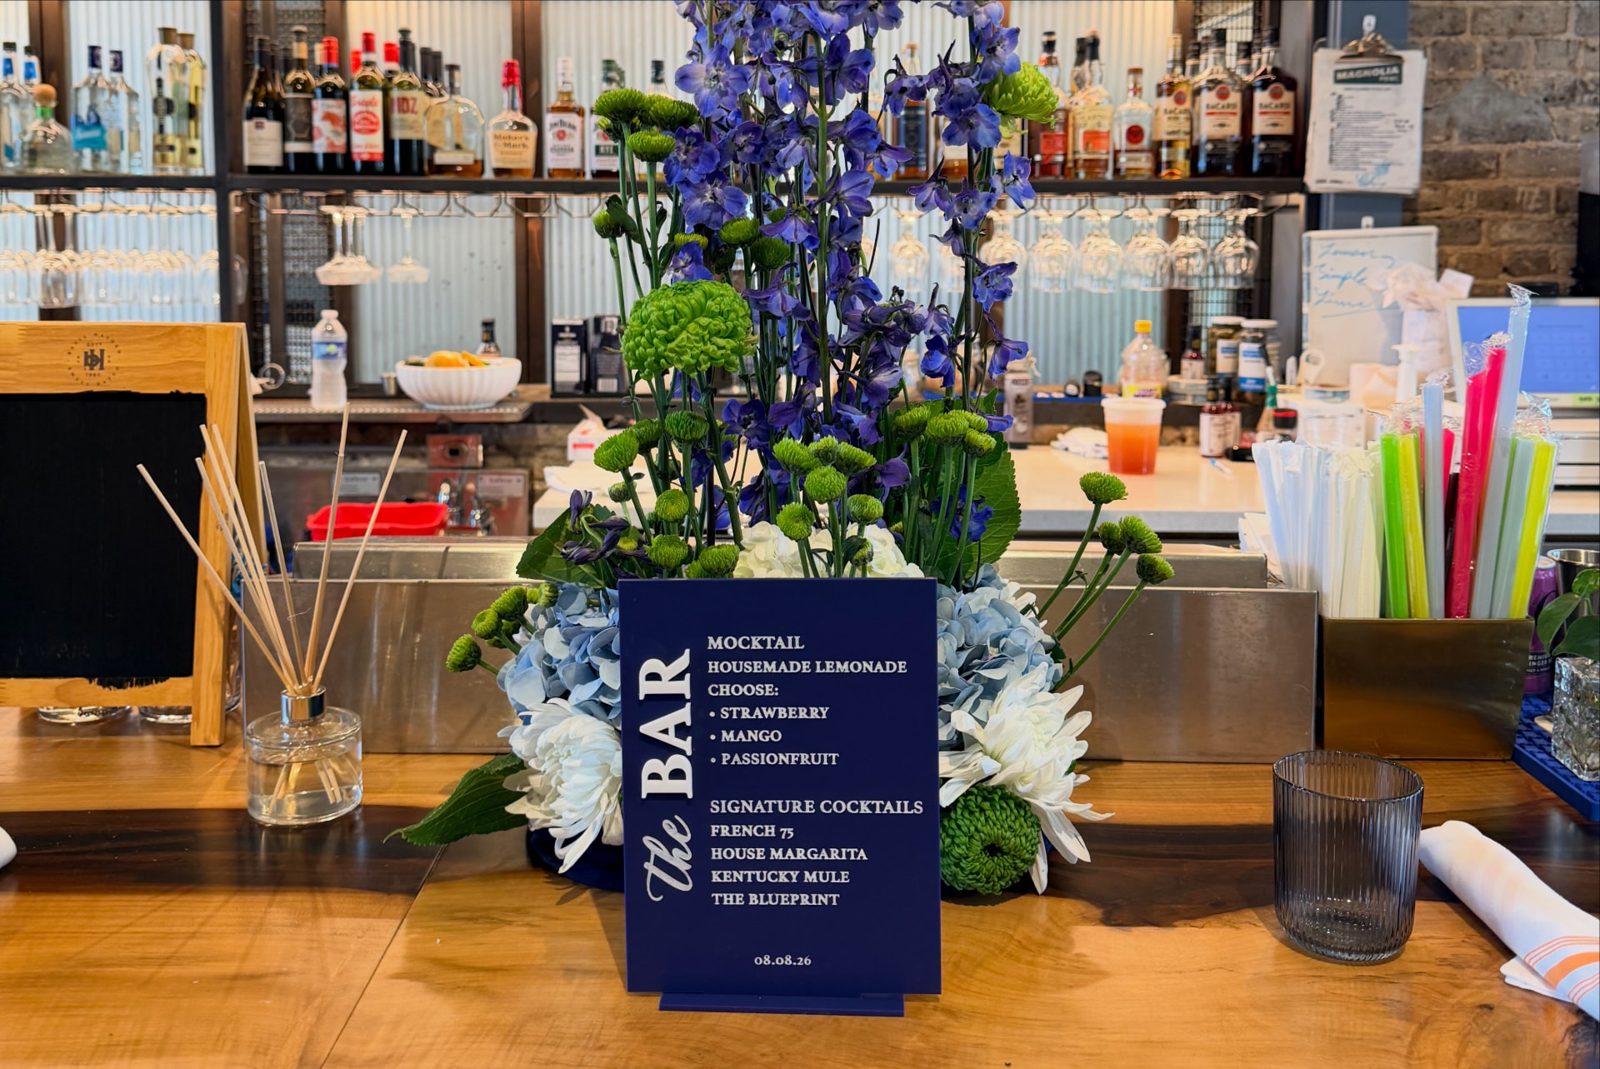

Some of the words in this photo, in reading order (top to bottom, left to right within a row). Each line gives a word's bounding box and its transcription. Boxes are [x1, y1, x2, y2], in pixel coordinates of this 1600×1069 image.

[1336, 66, 1399, 80] MAGNOLIA
[707, 635, 805, 650] MOCKTAIL
[707, 660, 812, 674] HOUSEMADE
[815, 660, 908, 673] LEMONADE
[707, 683, 779, 697] CHOOSE:
[720, 706, 830, 719] STRAWBERRY
[638, 648, 694, 799] BAR
[721, 729, 783, 742] MANGO
[721, 752, 840, 765] PASSIONFRUIT
[710, 799, 816, 814] SIGNATURE
[819, 799, 924, 815] COCKTAILS
[710, 824, 776, 837] FRENCH
[779, 827, 794, 840] 75
[710, 847, 766, 860] HOUSE
[769, 847, 868, 861] MARGARITA
[711, 870, 800, 883] KENTUCKY
[803, 870, 850, 883] MULE
[711, 893, 745, 905] THE
[748, 893, 840, 906] BLUEPRINT
[754, 954, 812, 966] 08.08.26
